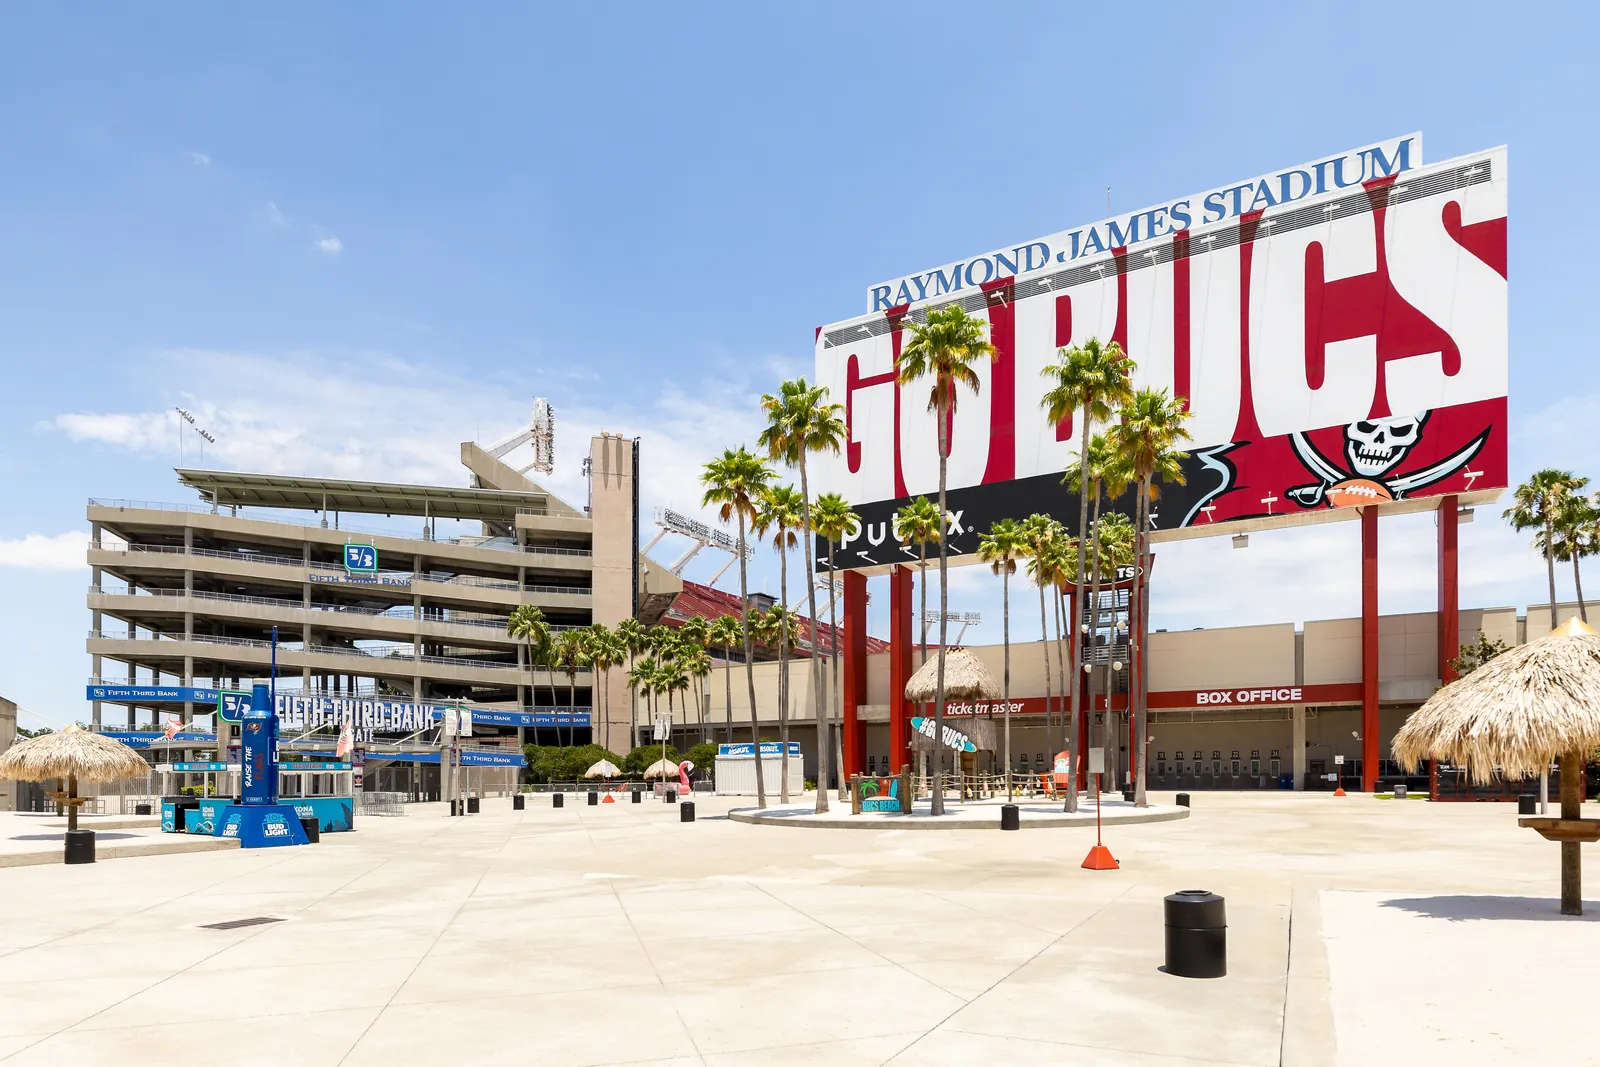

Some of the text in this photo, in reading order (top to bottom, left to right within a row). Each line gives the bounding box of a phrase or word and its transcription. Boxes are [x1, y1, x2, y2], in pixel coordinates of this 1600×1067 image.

[871, 137, 1415, 312] RAYMOND JAMES STADIUM
[815, 145, 1508, 506] GO BUCS
[841, 509, 964, 550] Pubx
[308, 574, 412, 587] FIFTH THIRD BANK
[1196, 688, 1302, 705] BOX OFFICE
[275, 695, 325, 725] FIFTH
[330, 699, 385, 728] THIRD
[391, 703, 434, 730] BANK
[351, 728, 374, 742] ATE
[244, 745, 253, 787] RAISE THE
[862, 800, 900, 811] BUCS BEACH
[222, 829, 238, 837] LIGHT
